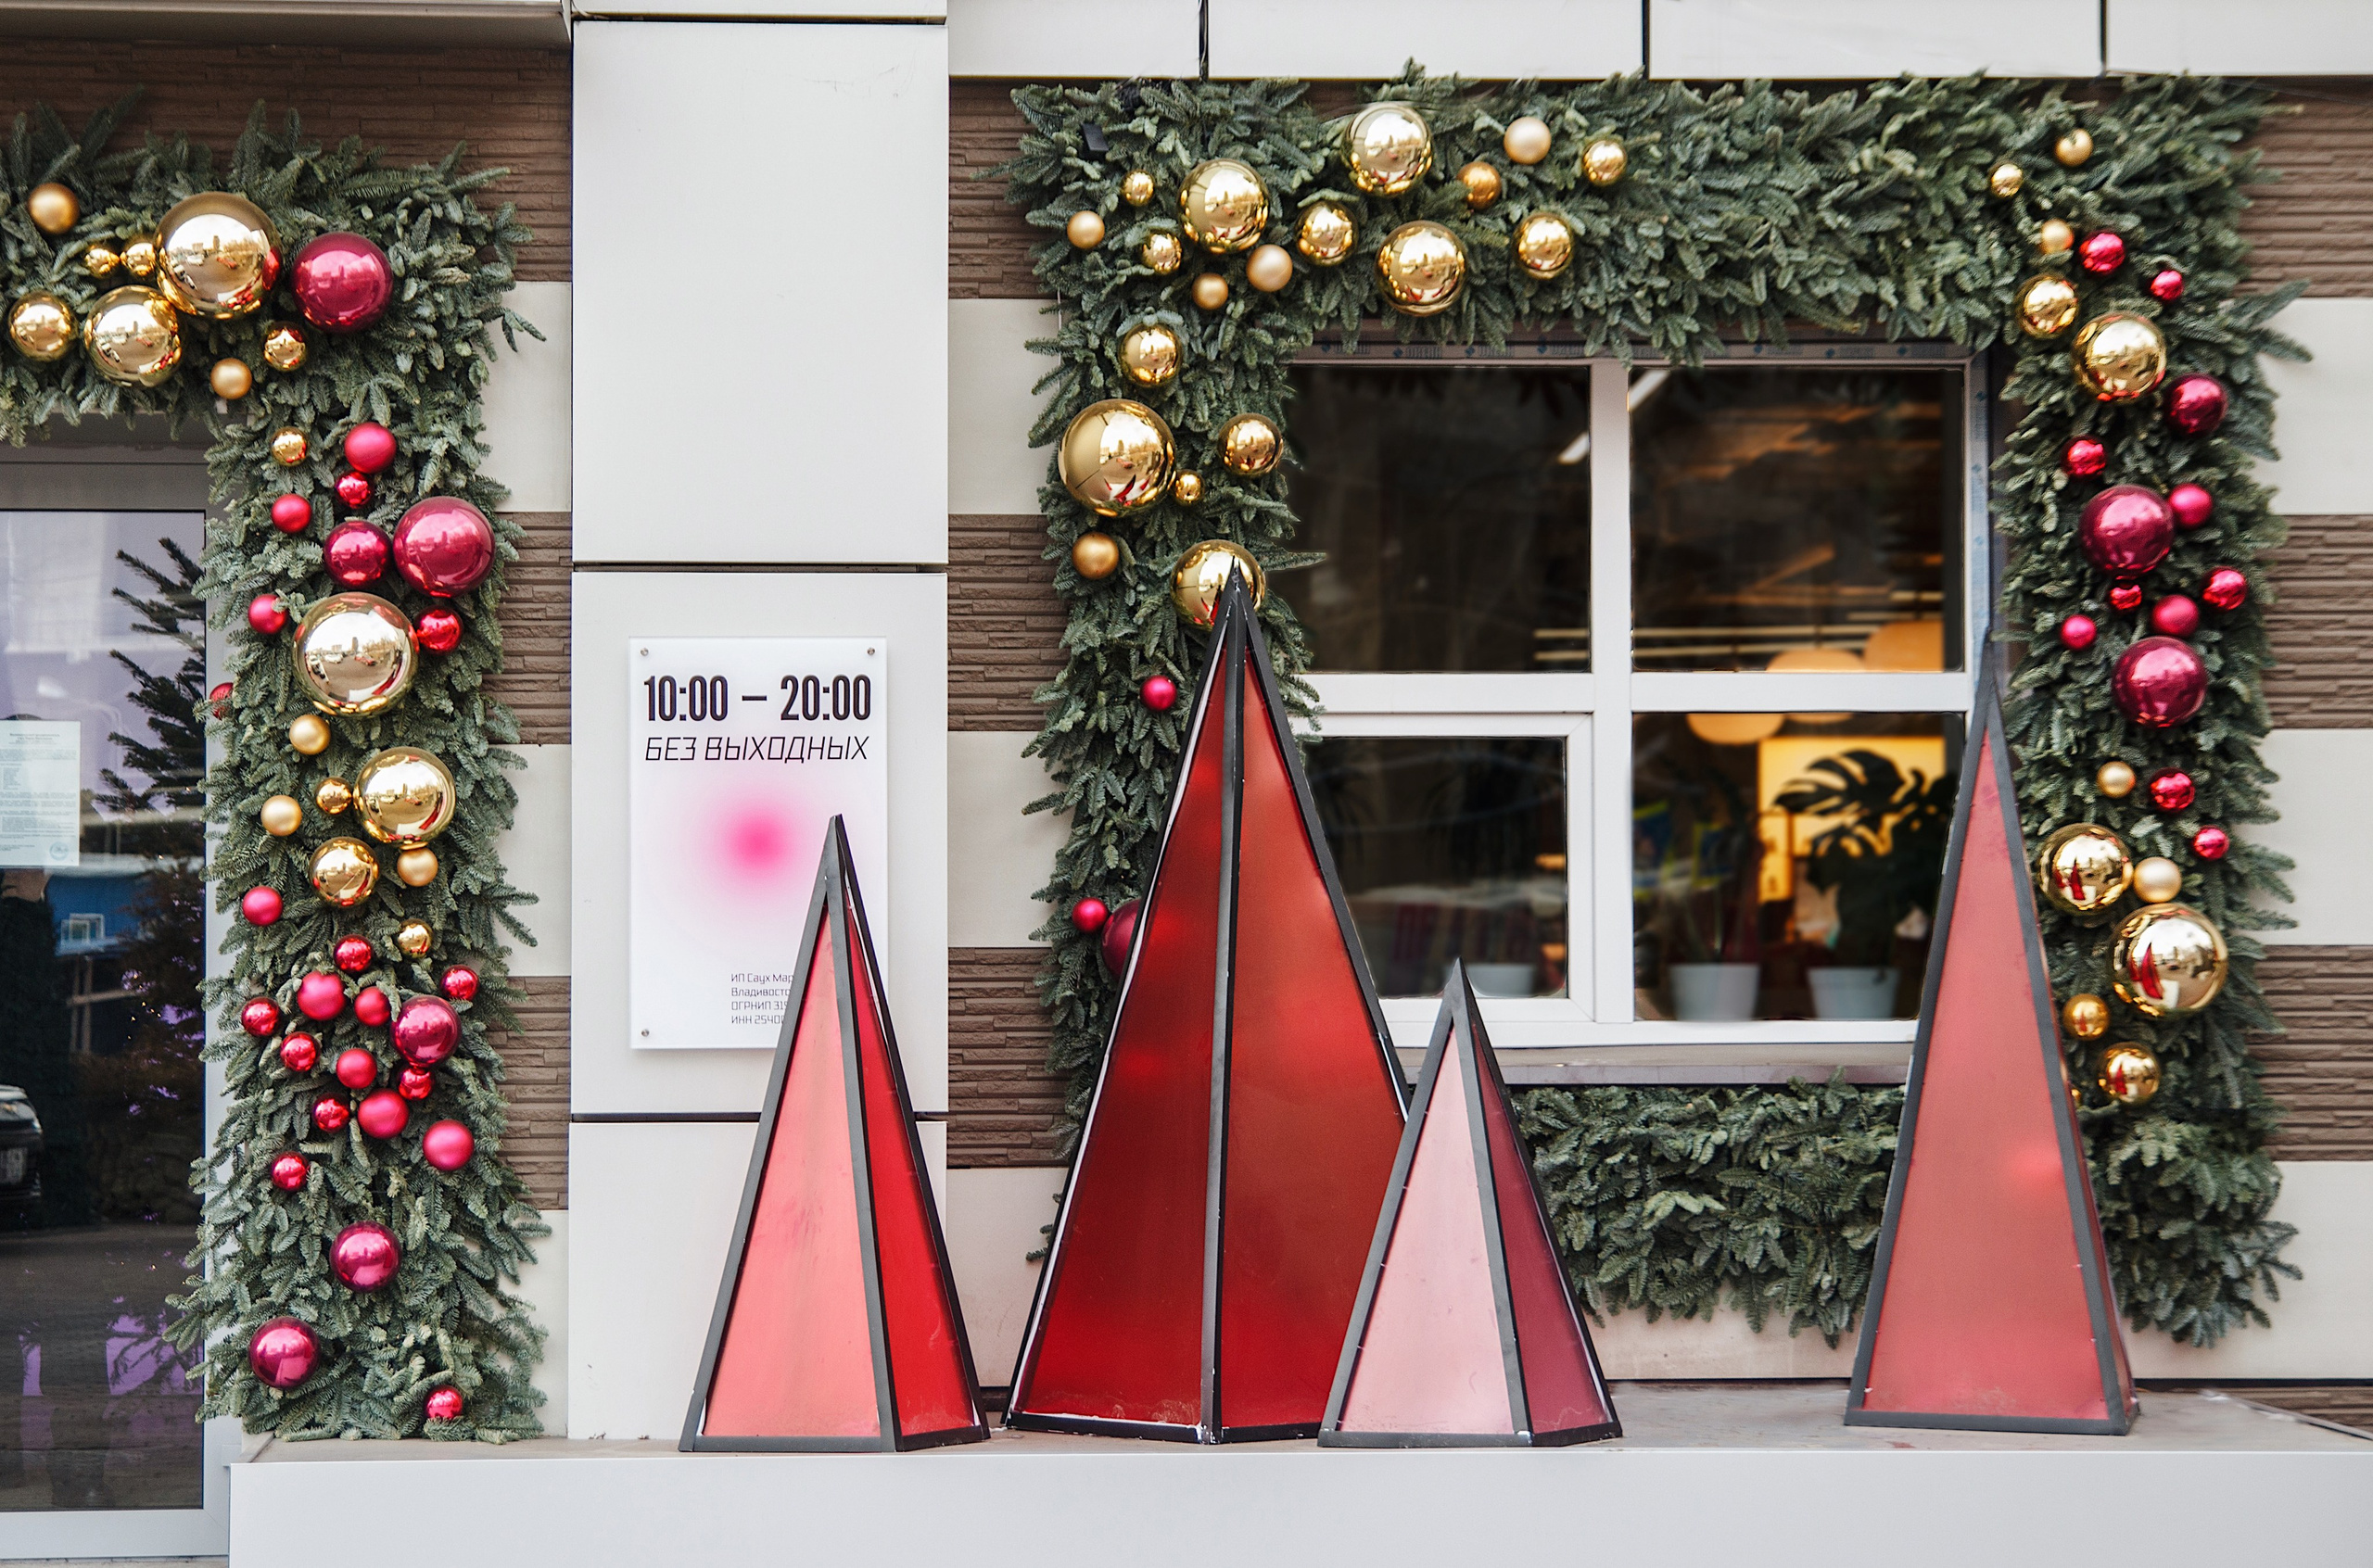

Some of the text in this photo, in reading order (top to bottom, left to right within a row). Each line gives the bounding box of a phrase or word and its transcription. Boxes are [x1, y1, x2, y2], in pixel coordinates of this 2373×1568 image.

[644, 675, 728, 721] 10:00
[780, 674, 871, 721] 20:00
[645, 736, 869, 764] БЕЗ ВЫХОДНЫХ
[731, 973, 745, 982] ИП
[747, 973, 771, 984] Саух
[731, 1001, 771, 1010] ОГРНИП
[731, 1015, 753, 1024] ИНН
